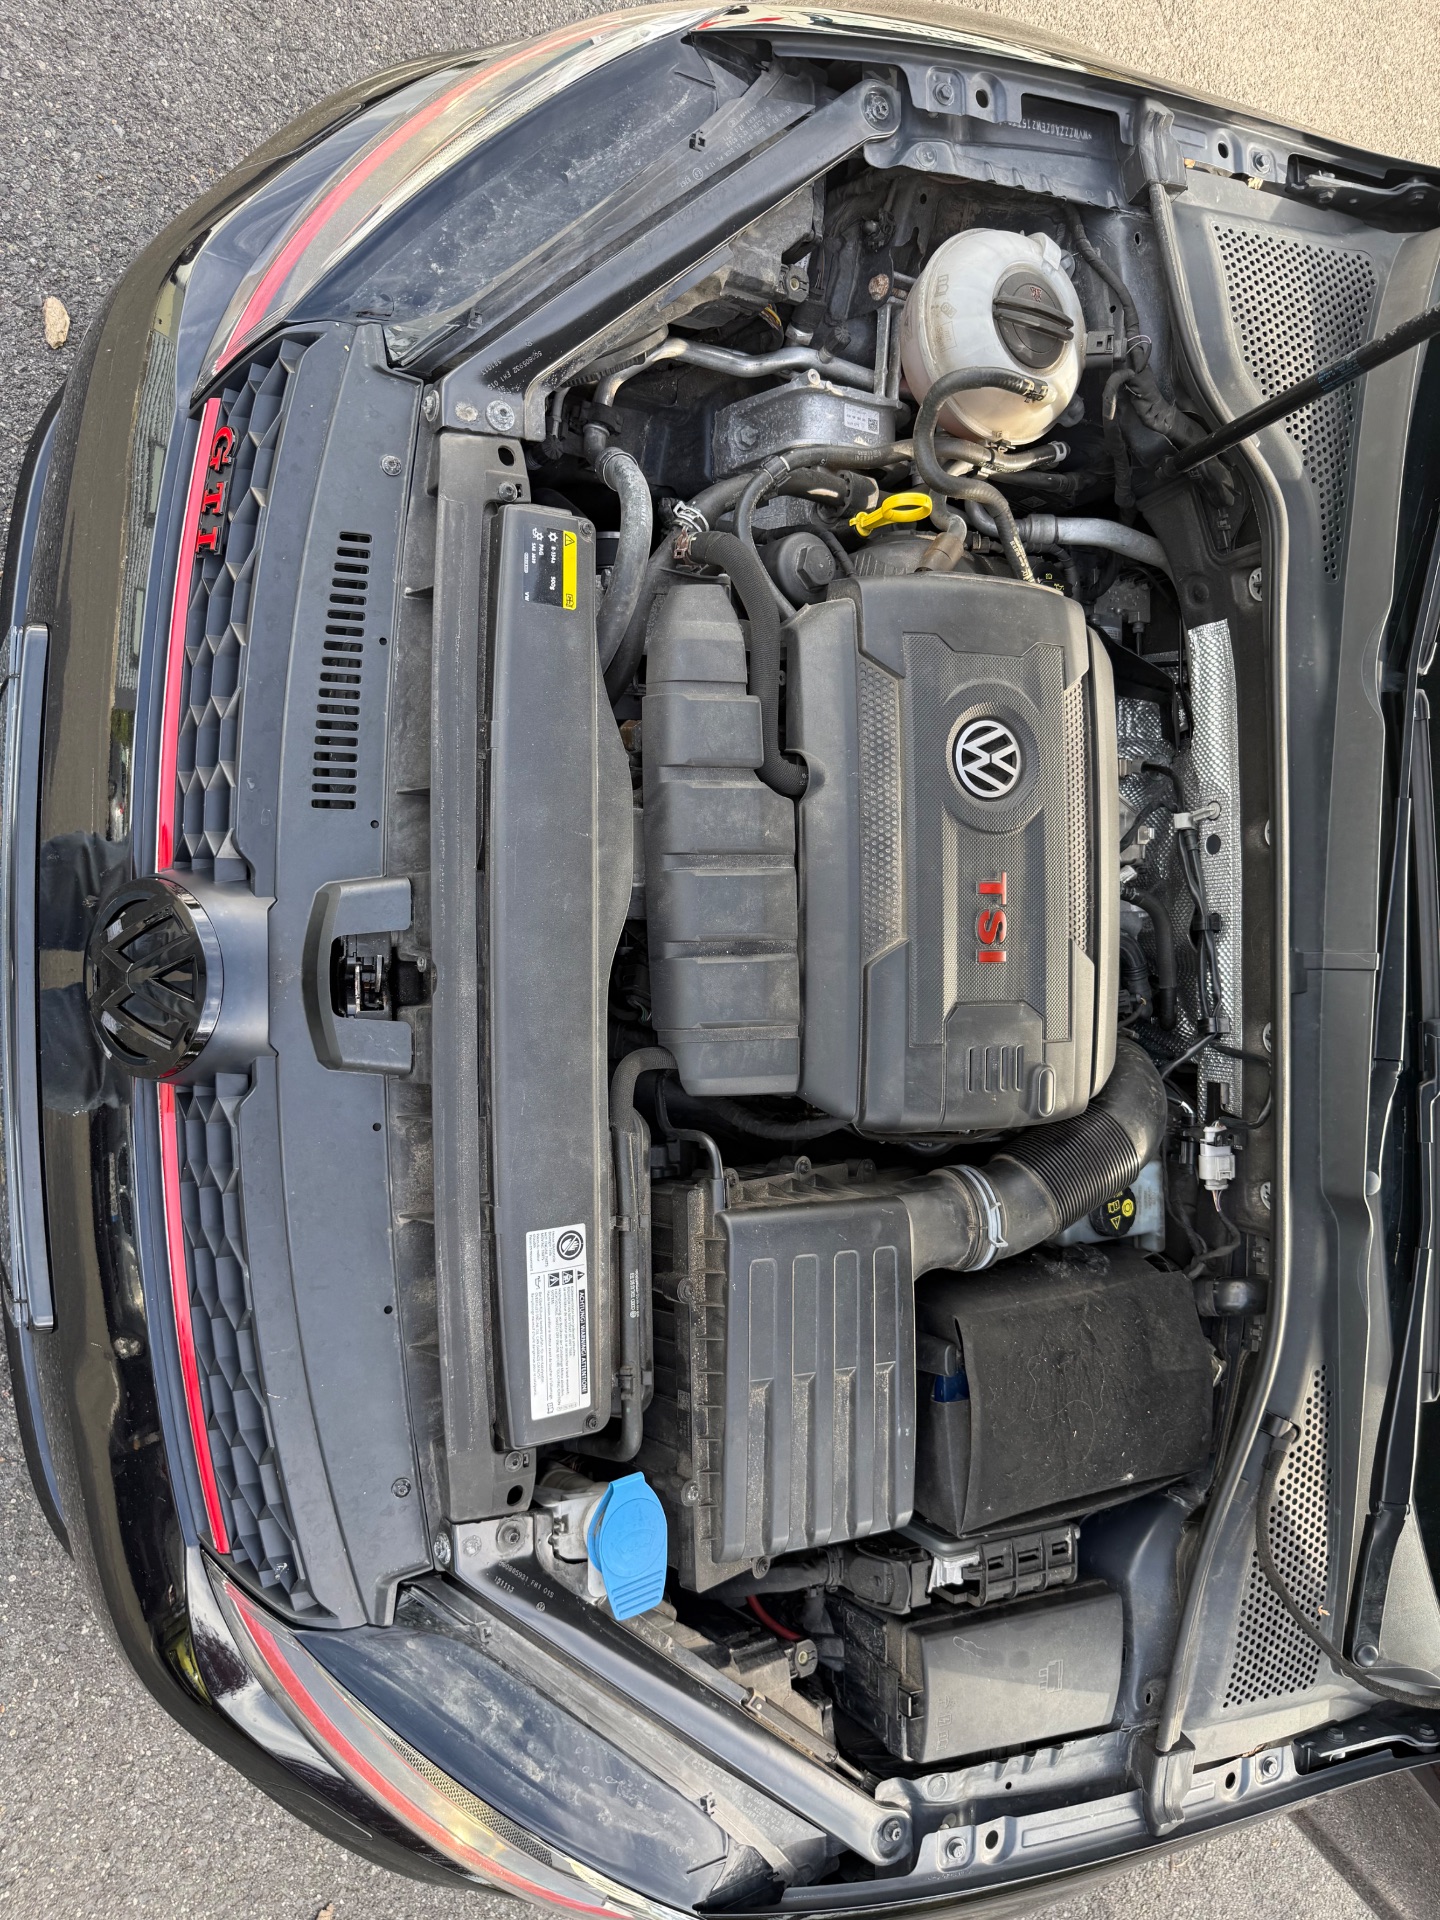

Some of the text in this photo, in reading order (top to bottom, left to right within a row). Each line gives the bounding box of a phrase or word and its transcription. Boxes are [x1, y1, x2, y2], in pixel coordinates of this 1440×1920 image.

[195, 425, 236, 556] GTI
[955, 719, 1022, 799] VW
[975, 871, 1007, 965] TSI
[84, 877, 223, 1083] VW
